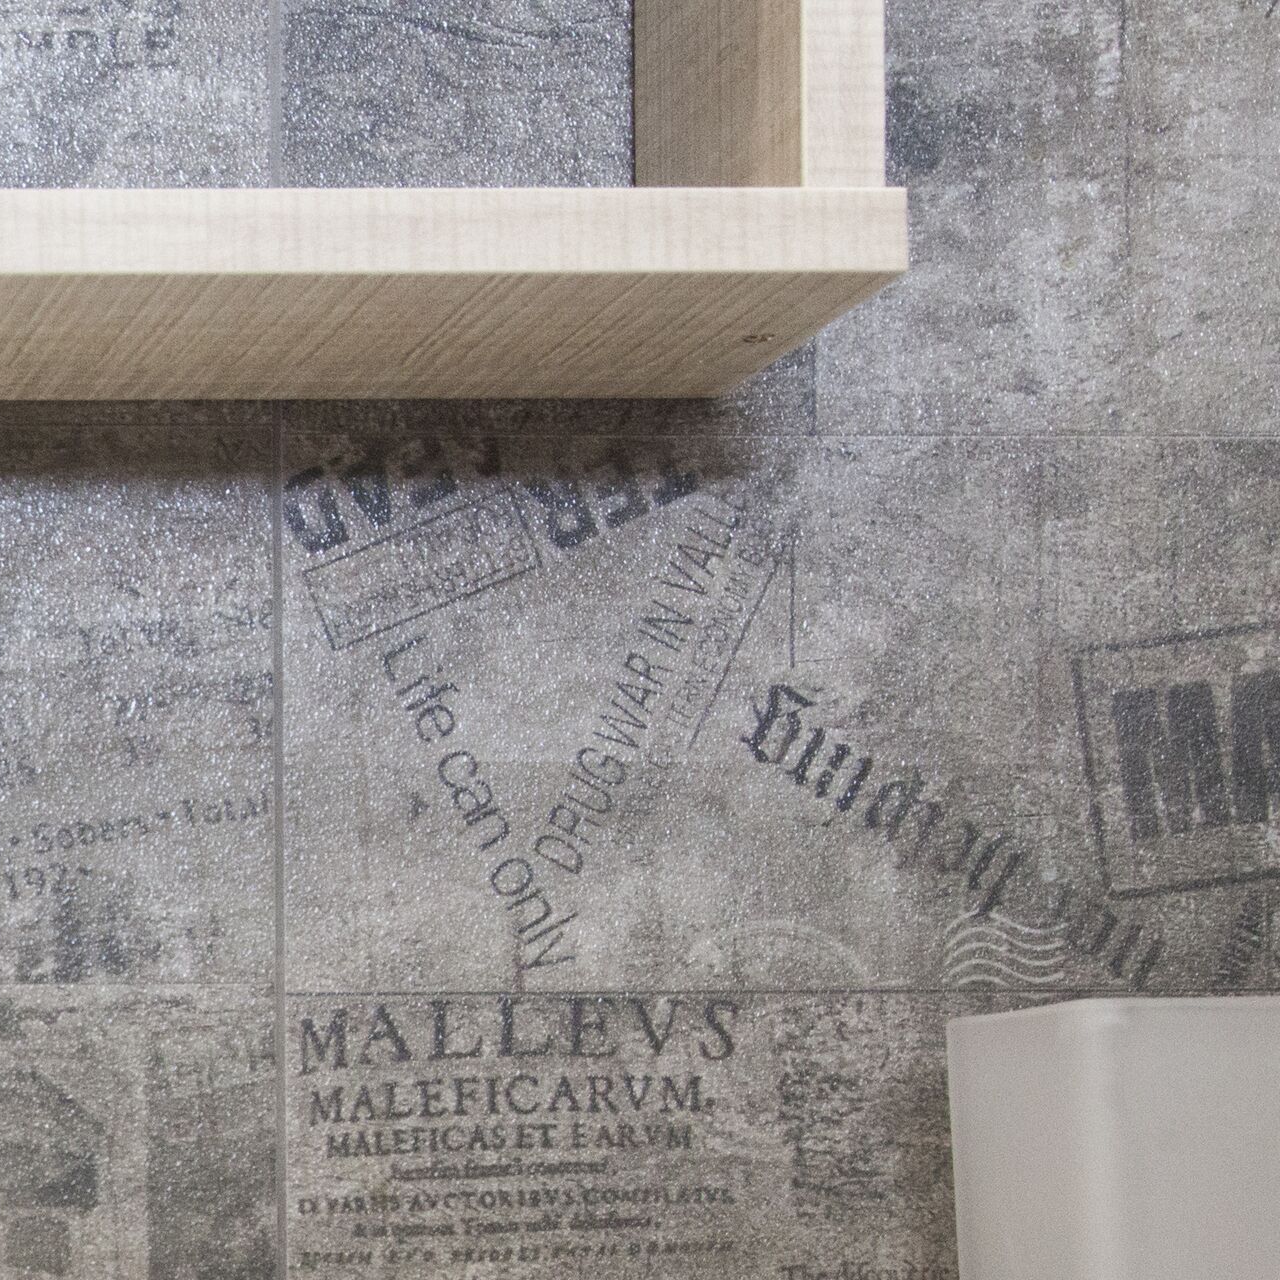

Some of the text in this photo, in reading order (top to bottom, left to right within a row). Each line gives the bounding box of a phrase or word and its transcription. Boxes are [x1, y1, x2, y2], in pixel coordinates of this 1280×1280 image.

[378, 631, 578, 979] Life can only
[532, 744, 630, 874] DRUG
[299, 996, 740, 1076] MALLEVS
[326, 1125, 507, 1159] MALEFICAS
[518, 1123, 558, 1150] ET
